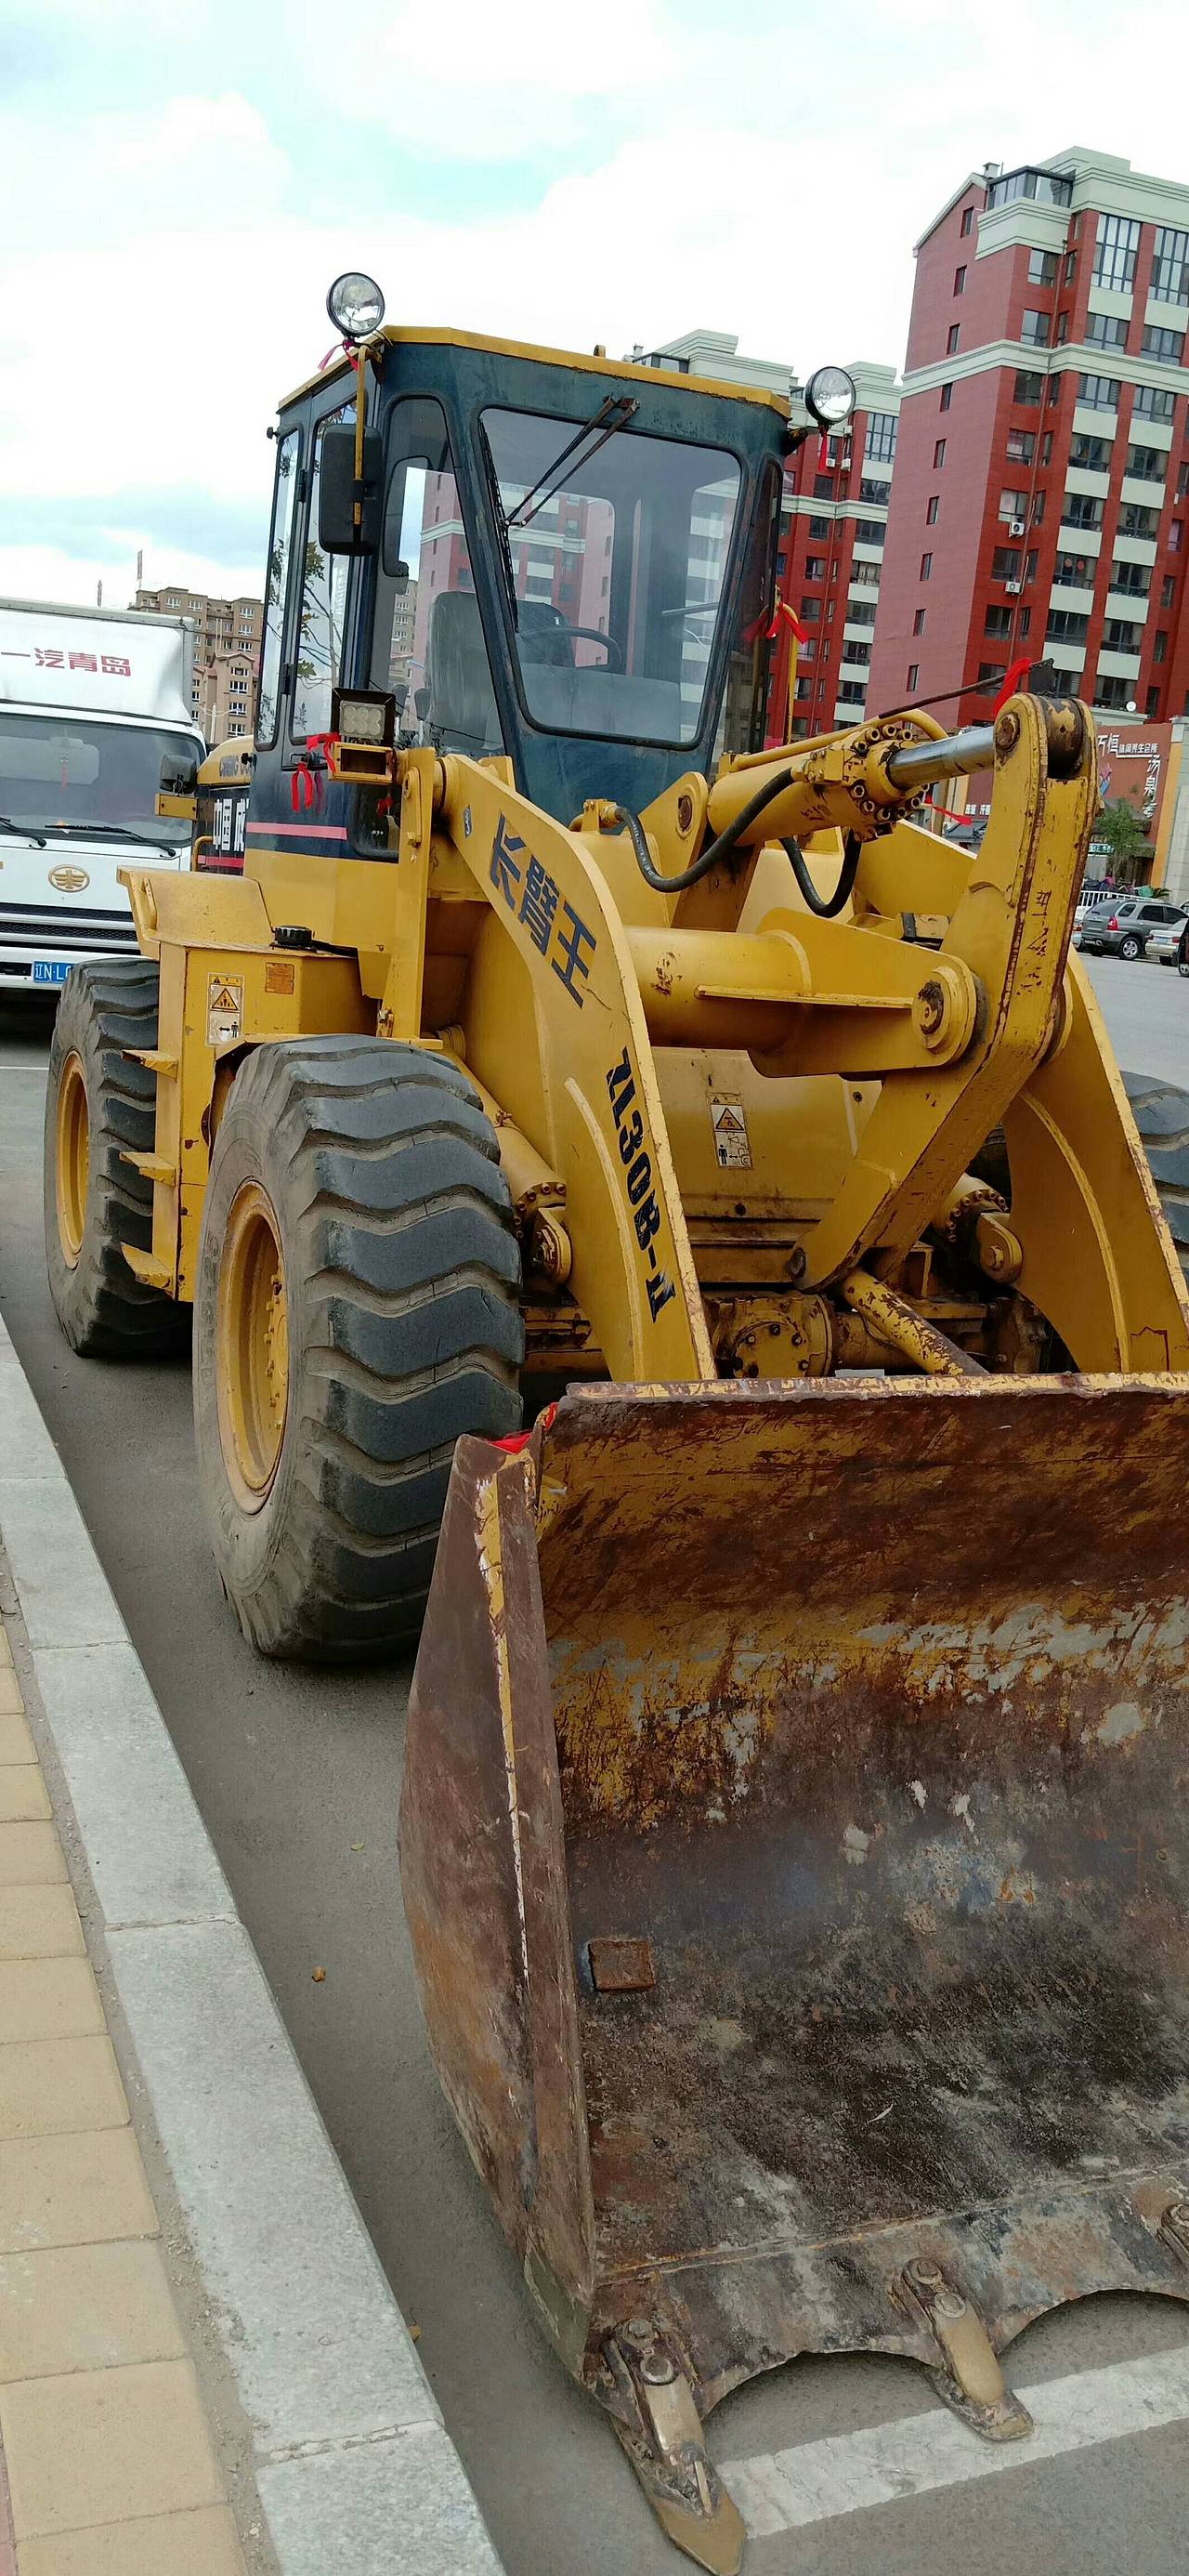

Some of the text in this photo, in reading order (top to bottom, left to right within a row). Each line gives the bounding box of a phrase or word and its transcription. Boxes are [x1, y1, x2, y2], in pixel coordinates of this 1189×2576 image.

[1, 648, 131, 677] 一汽青岛
[1097, 732, 1119, 757] 万恒
[490, 810, 597, 1009] 长臂王
